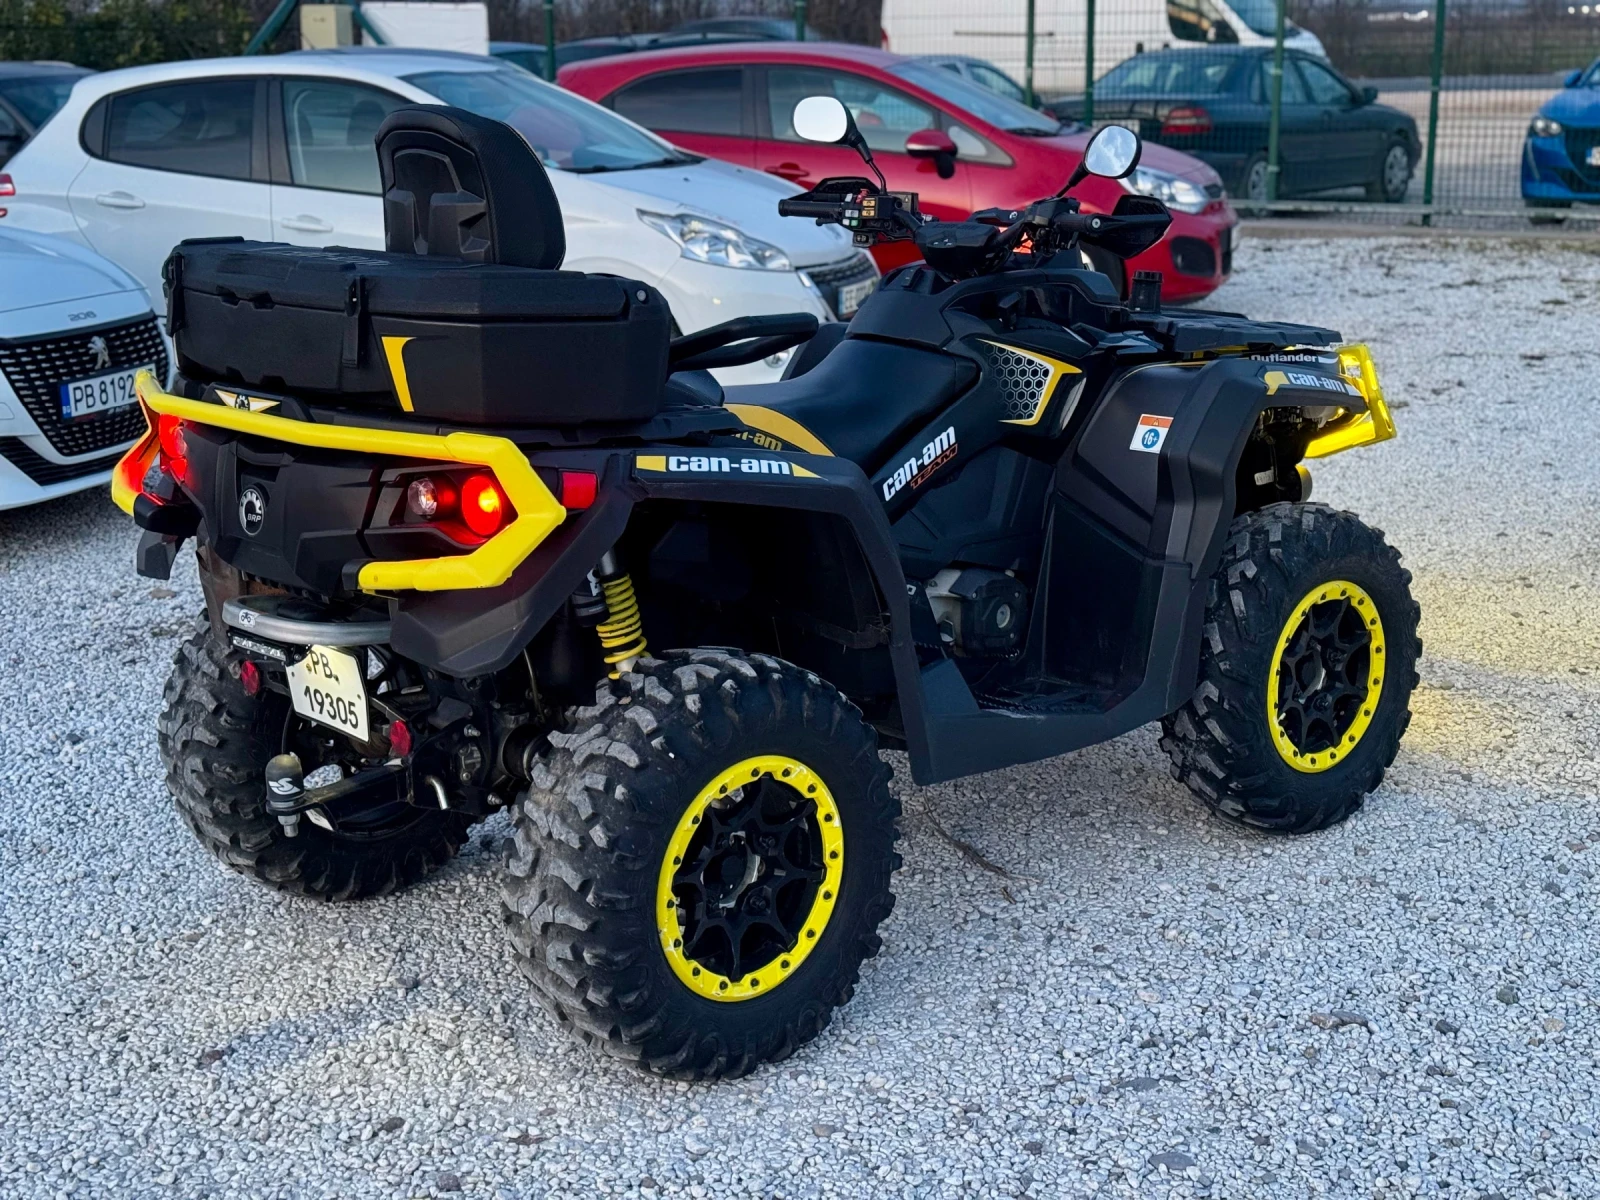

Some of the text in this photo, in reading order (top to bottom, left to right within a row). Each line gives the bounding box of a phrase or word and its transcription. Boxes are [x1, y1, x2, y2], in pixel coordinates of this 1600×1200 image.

[73, 374, 136, 412] PB 8192
[1288, 372, 1346, 394] can-am
[731, 430, 782, 451] n-am
[1143, 431, 1158, 446] 16+
[668, 456, 791, 475] can-am
[882, 425, 957, 502] can-am
[910, 443, 958, 490] TEAM
[247, 513, 262, 522] BRP
[310, 650, 333, 679] PB
[303, 685, 359, 730] 19305
